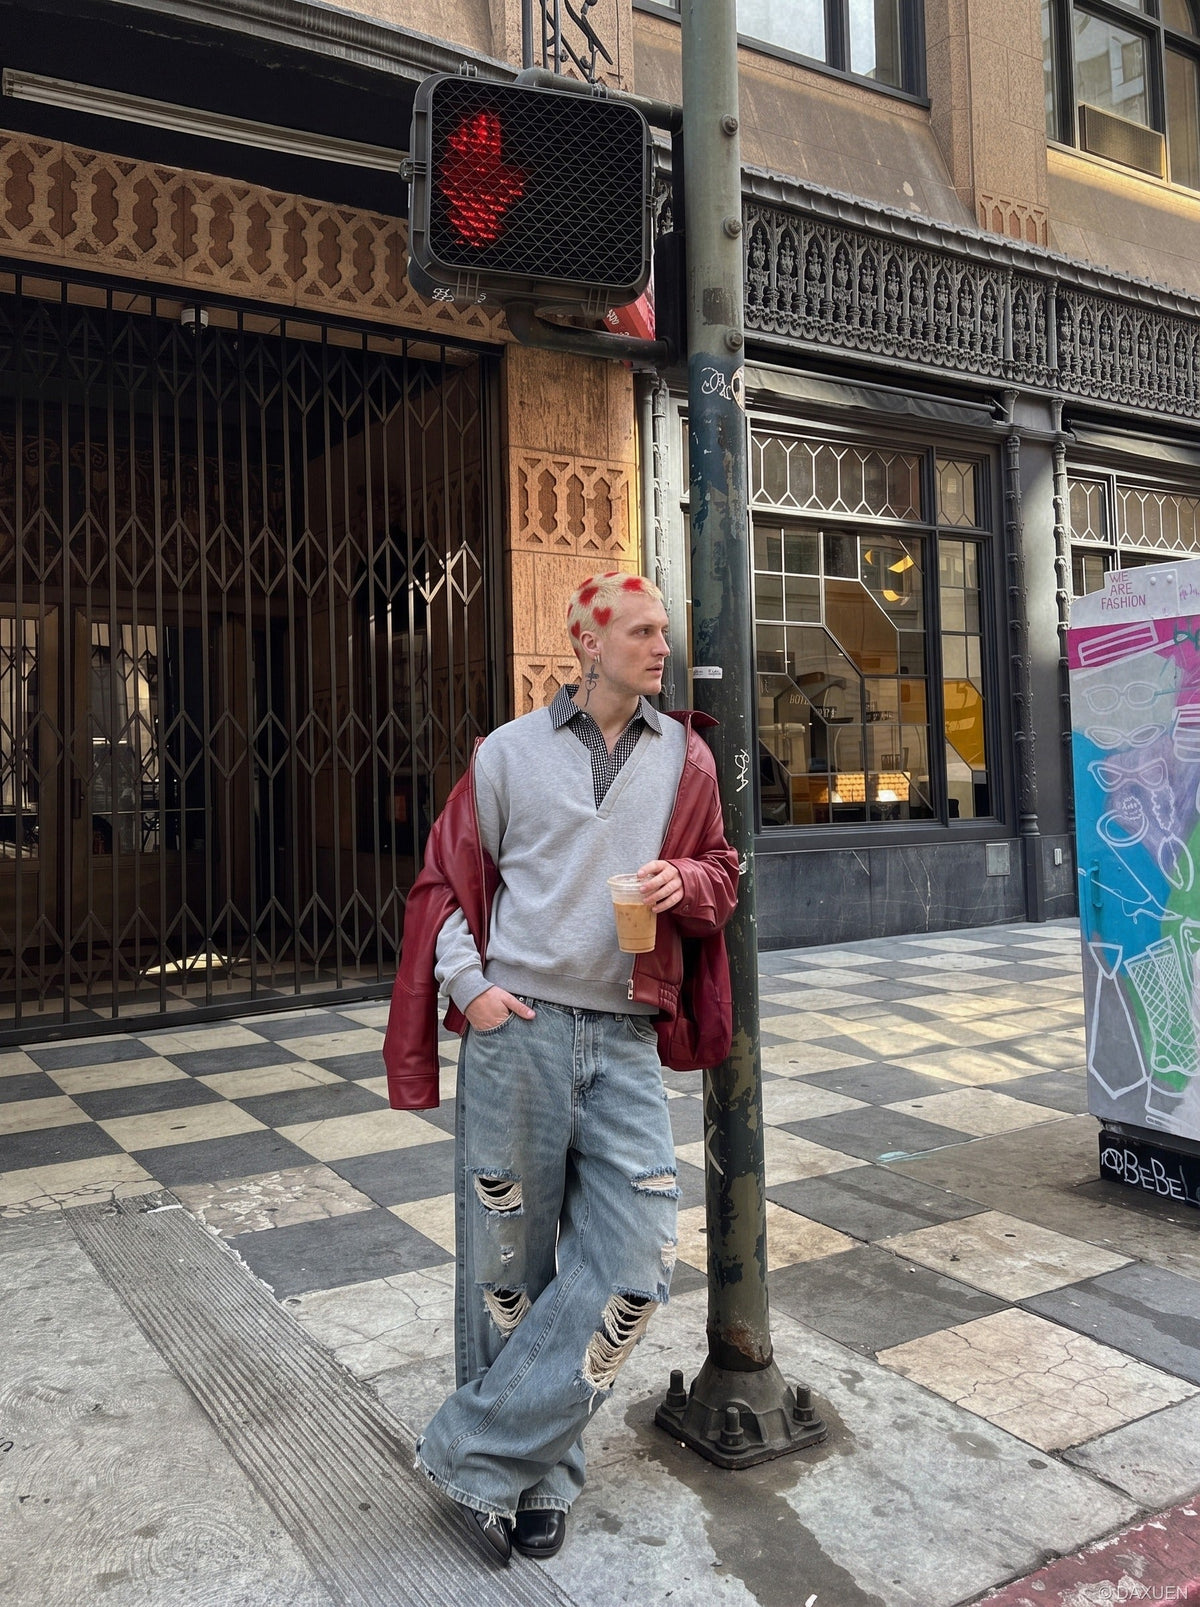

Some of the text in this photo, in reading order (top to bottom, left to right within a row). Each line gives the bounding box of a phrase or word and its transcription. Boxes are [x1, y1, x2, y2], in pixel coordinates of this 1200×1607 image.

[1109, 571, 1129, 583] WE
[1110, 582, 1133, 596] ARE
[1101, 595, 1146, 610] FASHION
